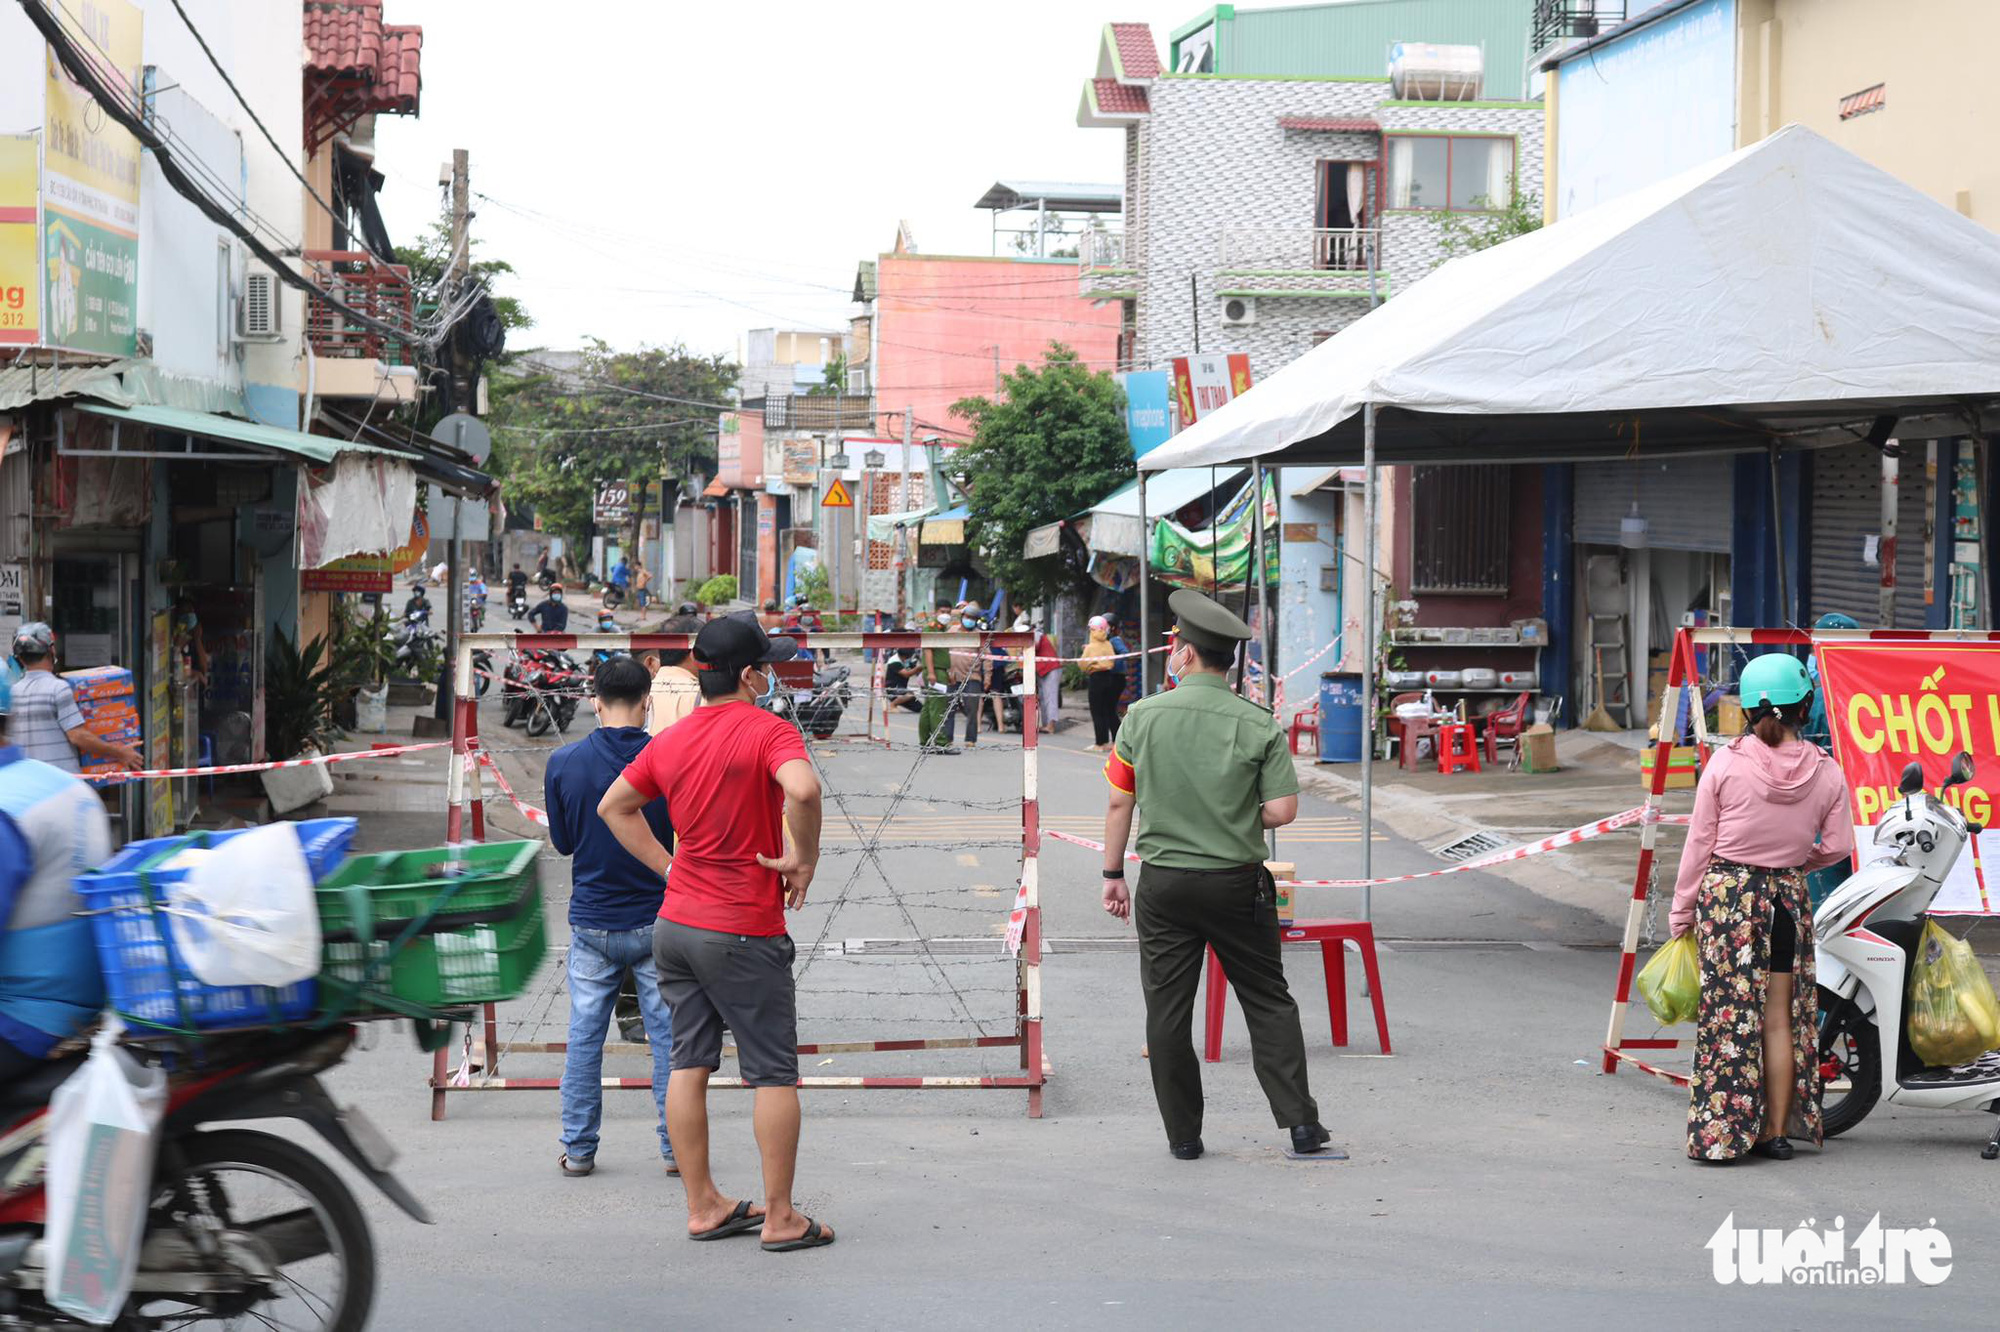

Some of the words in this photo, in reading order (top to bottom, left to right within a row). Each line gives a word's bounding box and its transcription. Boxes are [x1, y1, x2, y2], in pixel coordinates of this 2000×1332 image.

[0, 286, 25, 309] g
[1132, 402, 1165, 431] vinaphone
[599, 489, 627, 504] 159
[1848, 664, 1974, 755] CHỐT
